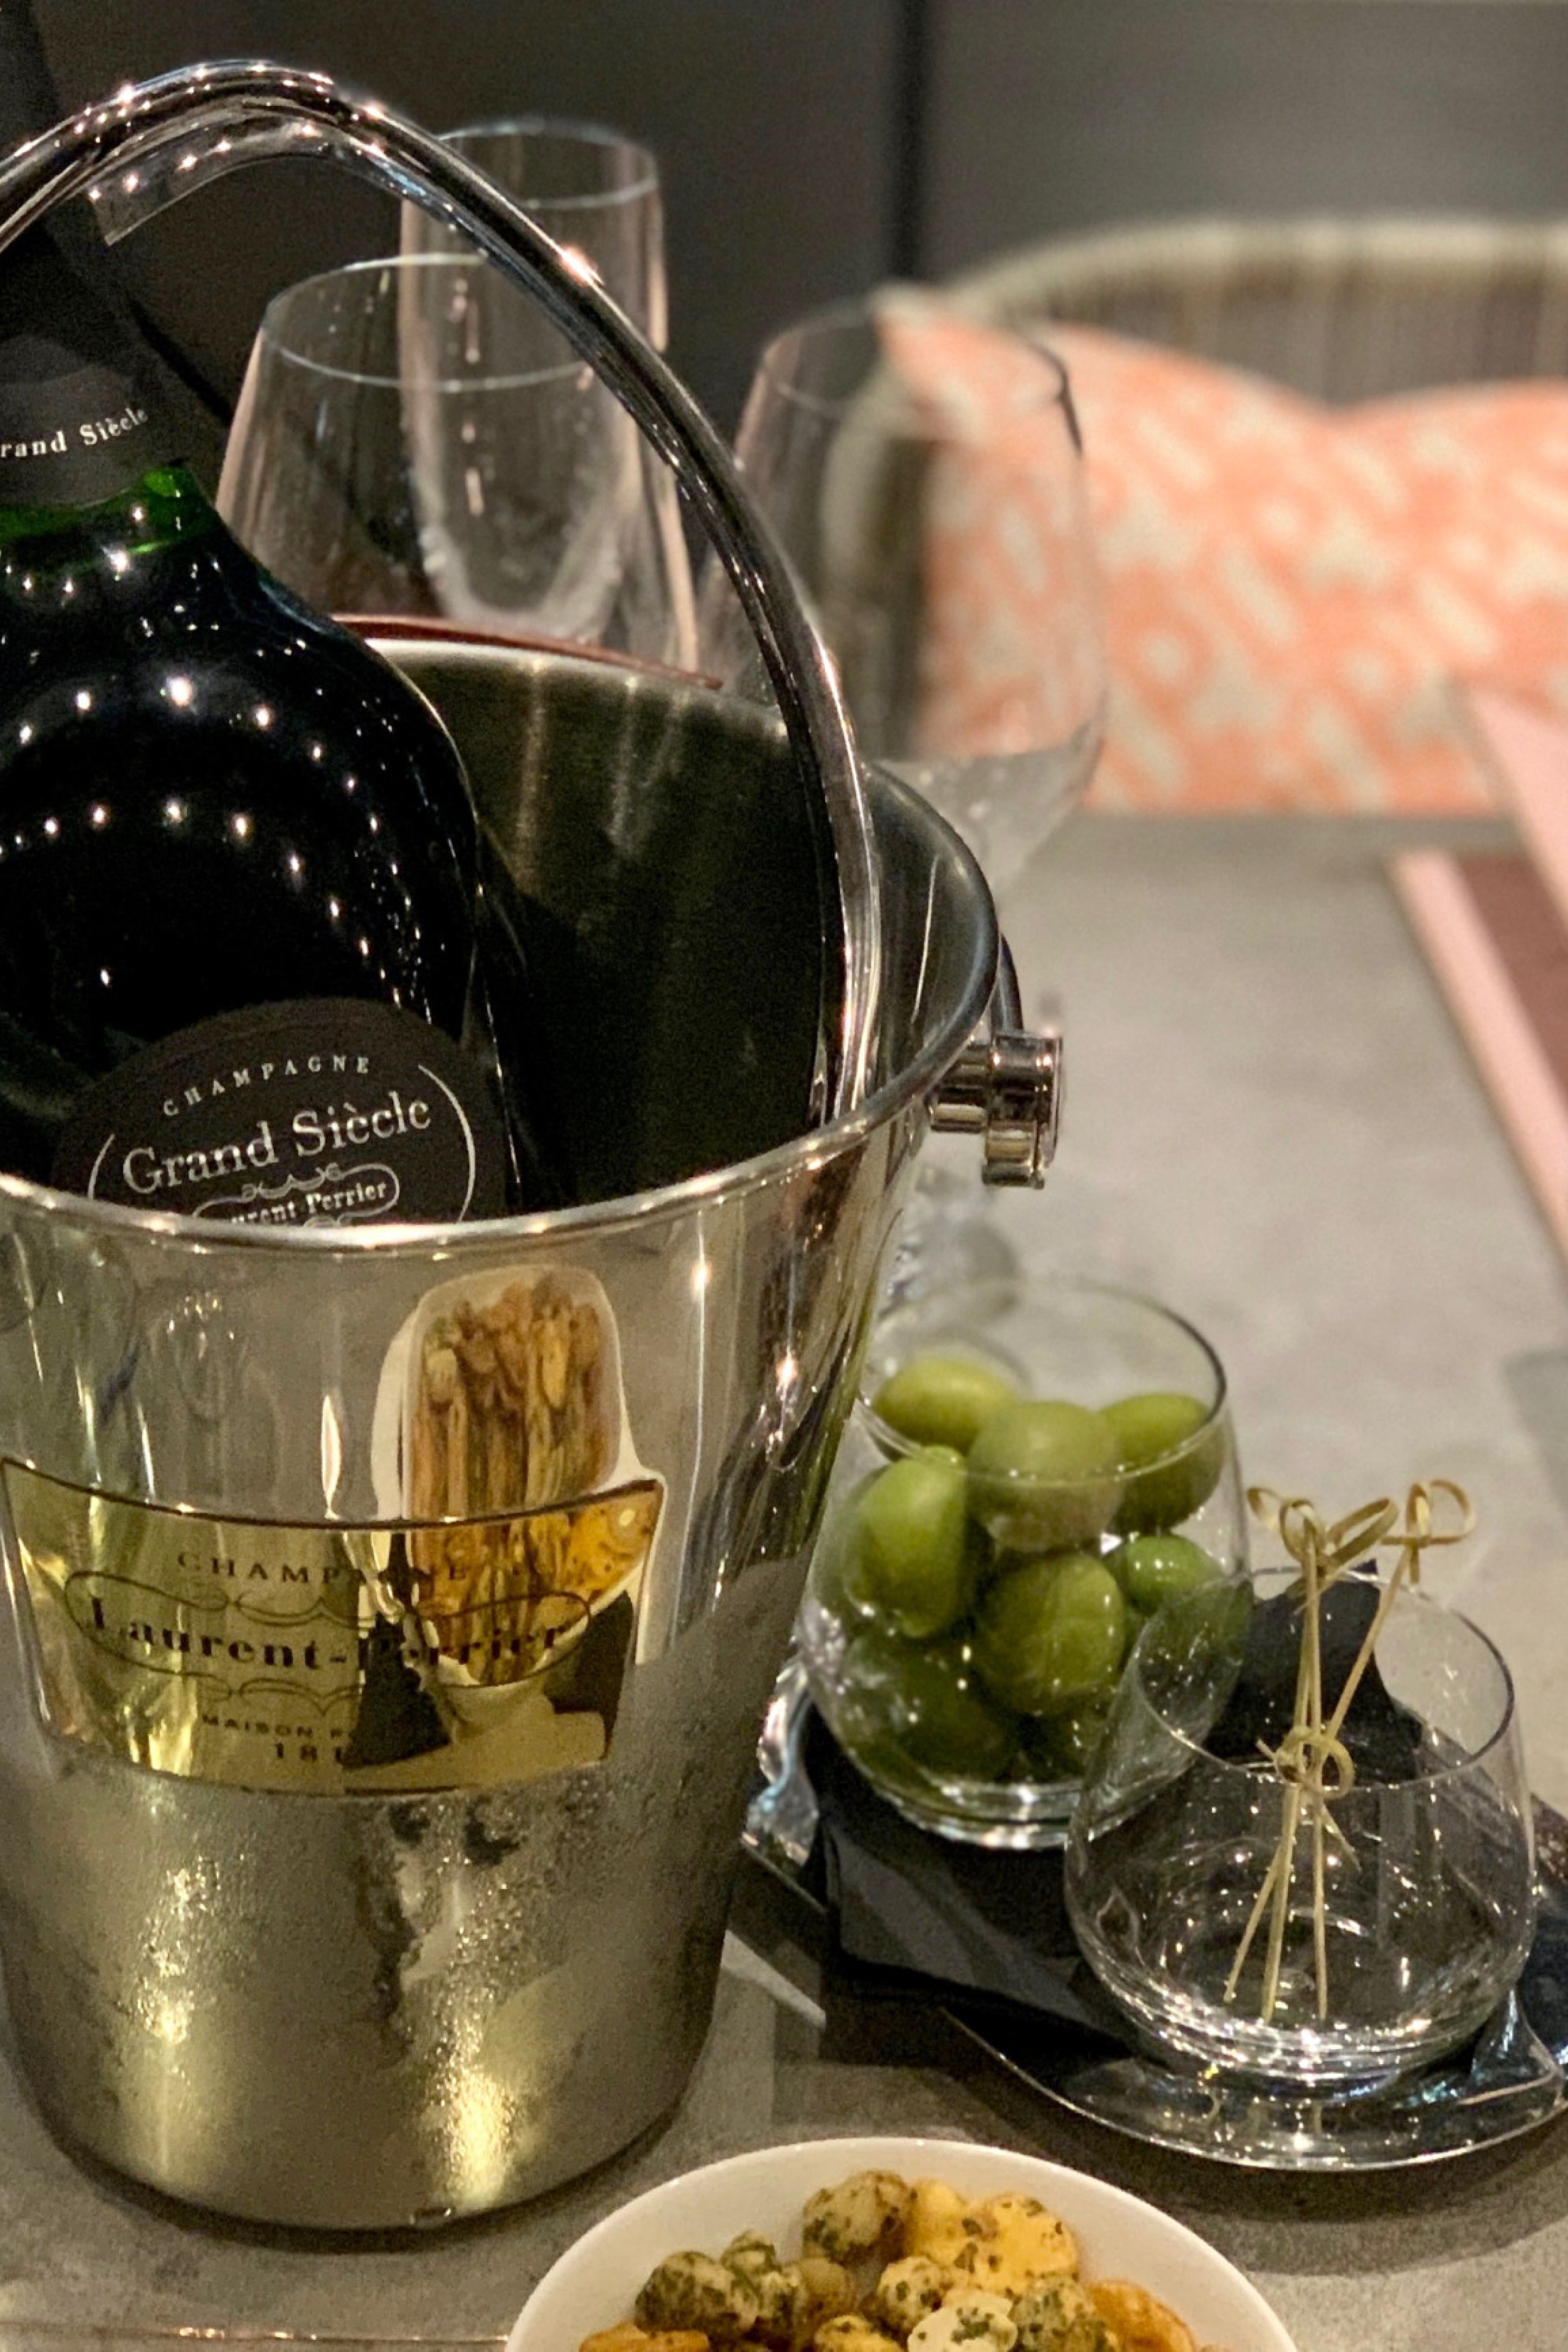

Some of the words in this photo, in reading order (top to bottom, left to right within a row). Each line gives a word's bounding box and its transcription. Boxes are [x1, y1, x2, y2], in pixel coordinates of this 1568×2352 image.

[0, 431, 67, 458] rand
[80, 407, 149, 445] Siècle
[163, 1055, 371, 1117] CHAMPAGNE
[123, 1121, 280, 1194] Grand
[292, 1091, 432, 1157] Siècle
[230, 1200, 298, 1224] rent
[305, 1182, 387, 1215] Perrier
[177, 1551, 469, 1585] CHAMPE
[202, 1714, 313, 1738] MAISON
